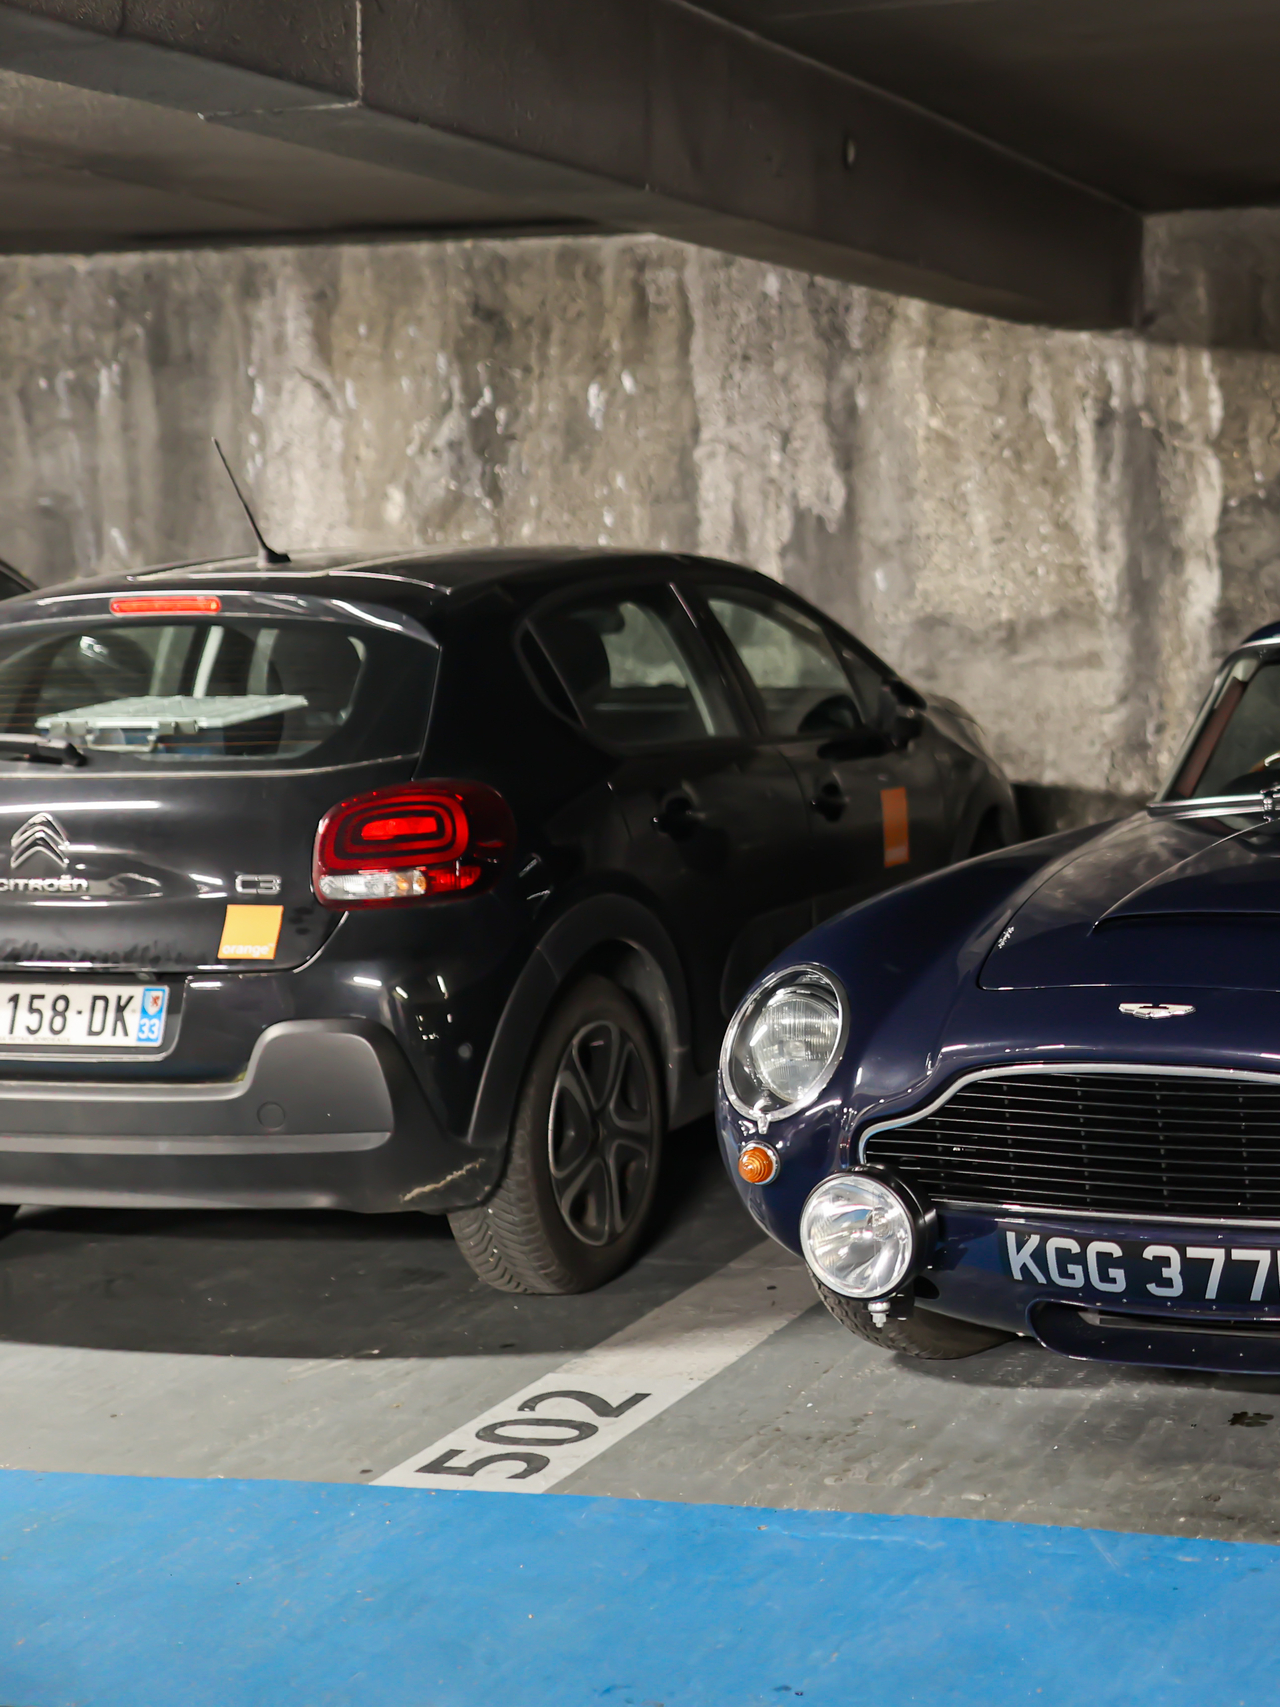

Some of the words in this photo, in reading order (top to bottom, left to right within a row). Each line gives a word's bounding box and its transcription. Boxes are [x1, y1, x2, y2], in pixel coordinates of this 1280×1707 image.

[235, 874, 281, 895] C3
[7, 993, 134, 1037] 158-DK
[138, 1018, 160, 1040] 33
[1005, 1231, 1127, 1293] KGG
[415, 1389, 652, 1480] 502
